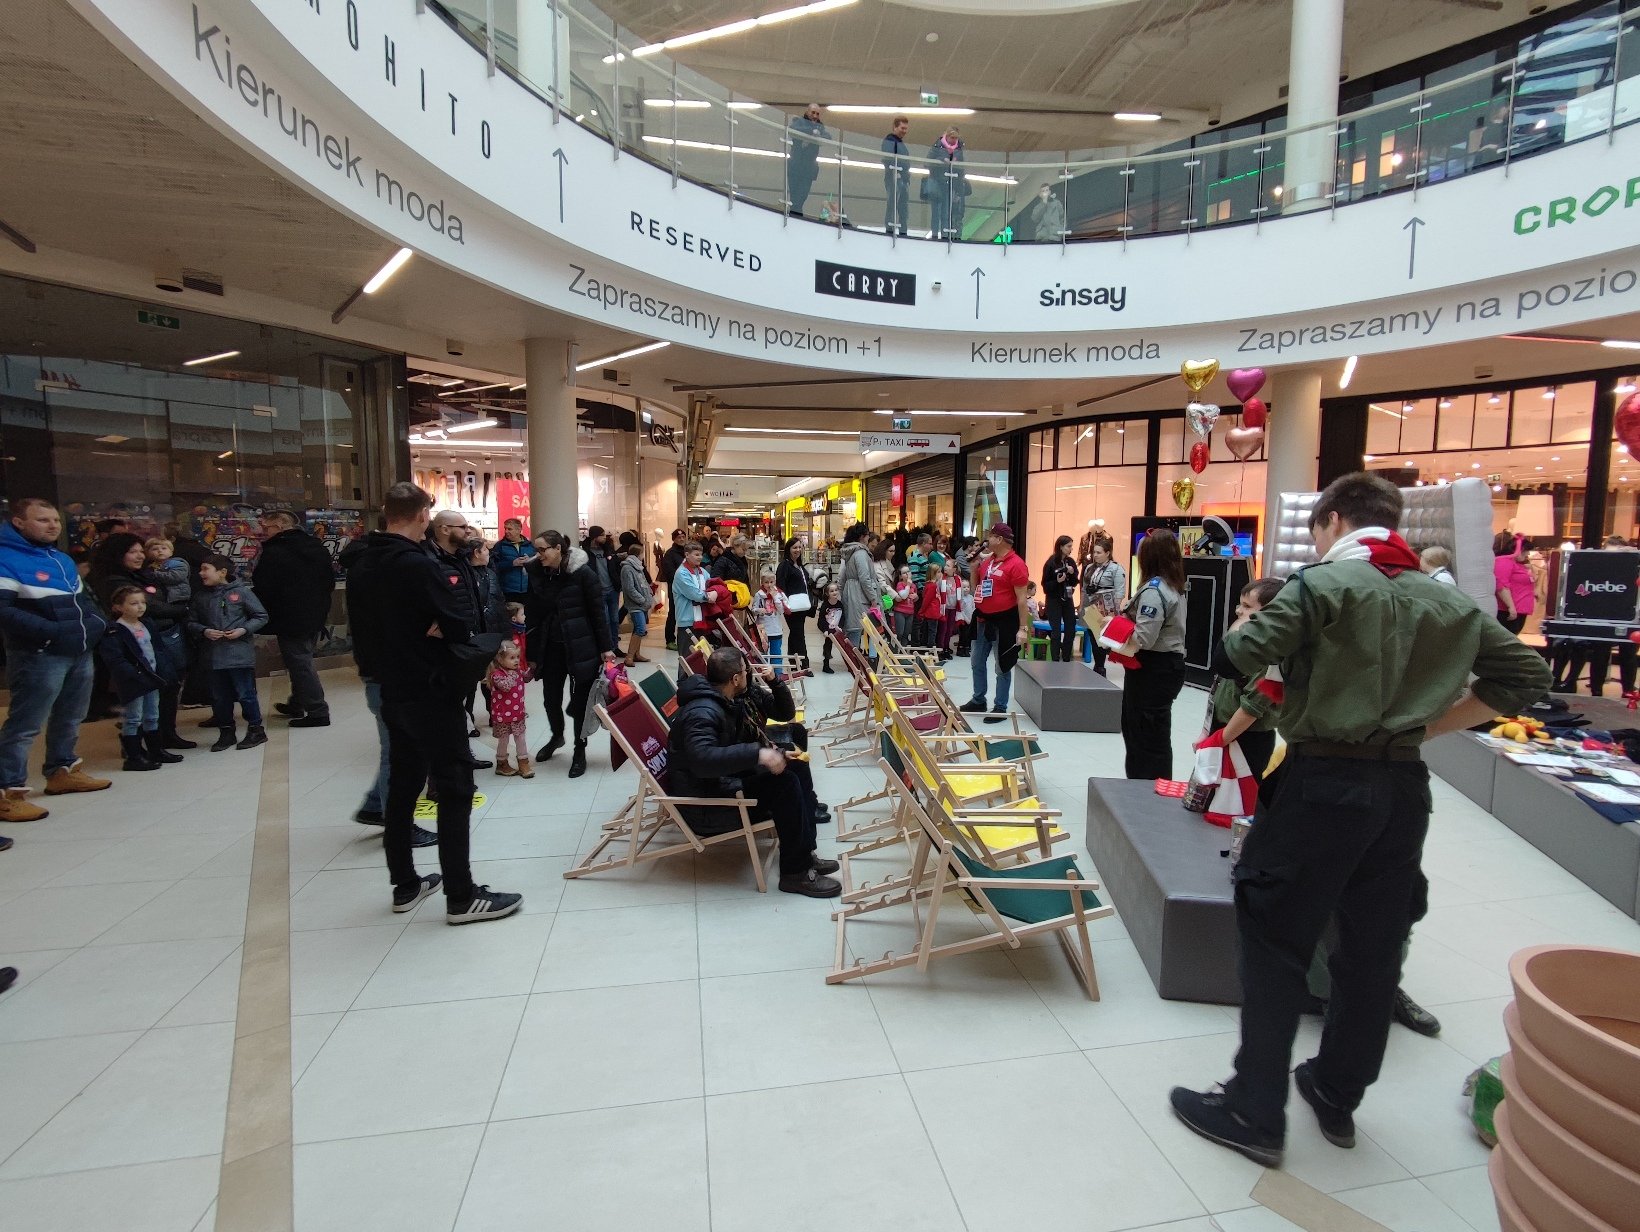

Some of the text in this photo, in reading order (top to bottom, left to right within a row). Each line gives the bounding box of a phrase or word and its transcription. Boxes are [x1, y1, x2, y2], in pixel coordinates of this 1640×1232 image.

[192, 3, 466, 246] Kierunek moda
[1513, 176, 1640, 236] CROP
[630, 211, 763, 272] RESERVED
[832, 269, 900, 299] CARRY
[1039, 282, 1127, 312] sinsay
[567, 264, 882, 358] Zapraszamy na poziom +1
[1237, 266, 1638, 353] Zapraszamy na pozio
[970, 338, 1161, 364] Kierunek moda
[884, 438, 904, 447] TAXI
[1585, 580, 1627, 593] hebe
